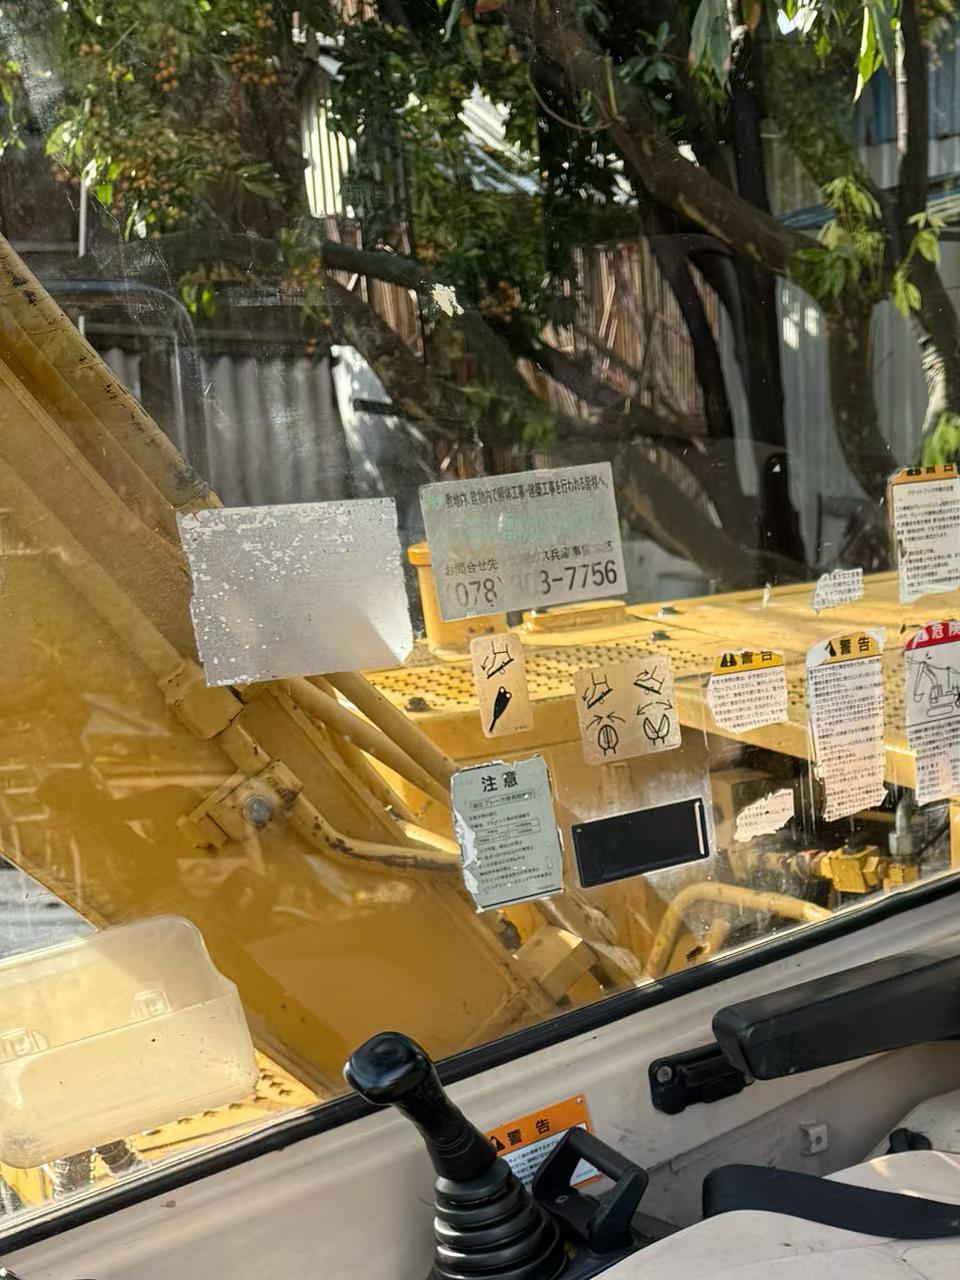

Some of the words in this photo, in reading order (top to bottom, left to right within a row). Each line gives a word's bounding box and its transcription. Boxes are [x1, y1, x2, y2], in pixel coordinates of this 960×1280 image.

[839, 635, 871, 656] 警告
[481, 770, 519, 793] 注意
[507, 1118, 551, 1146] 警告
